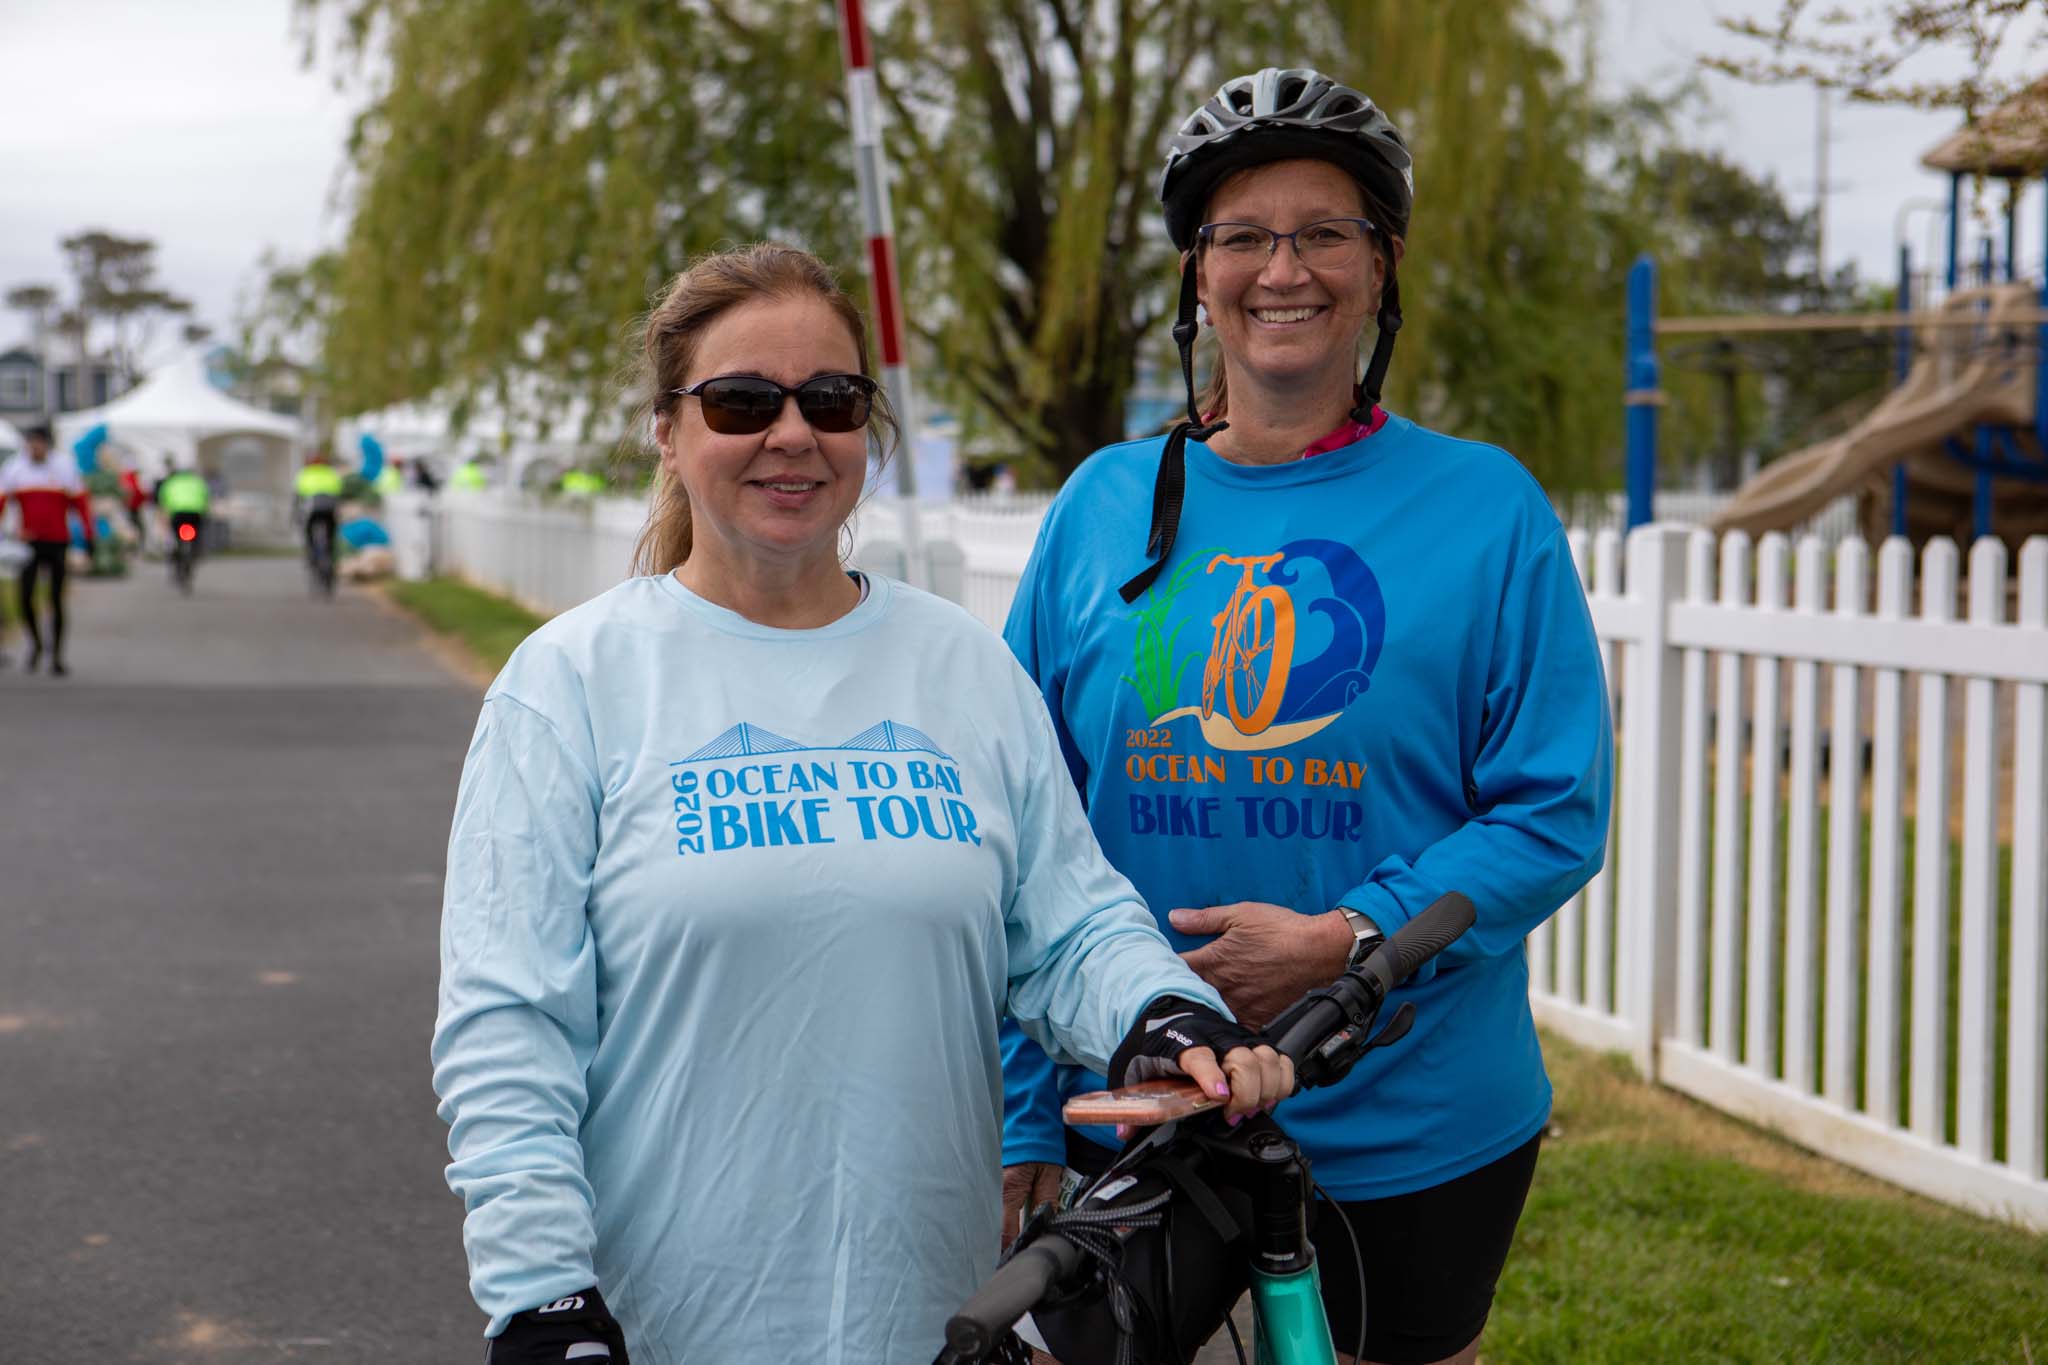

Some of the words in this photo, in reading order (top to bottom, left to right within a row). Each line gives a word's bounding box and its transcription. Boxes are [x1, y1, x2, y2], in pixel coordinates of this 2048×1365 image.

[1126, 729, 1172, 748] 2022
[706, 760, 839, 799] OCEAN
[847, 761, 898, 790] TO
[907, 760, 964, 796] BAY
[1126, 754, 1226, 783] OCEAN
[1247, 756, 1294, 785] TO
[1303, 758, 1367, 790] BAY
[672, 770, 705, 856] 2026
[708, 797, 836, 851] BIKE
[846, 795, 982, 847] TOUR
[1129, 793, 1222, 840] BIKE
[1236, 796, 1364, 843] TOUR
